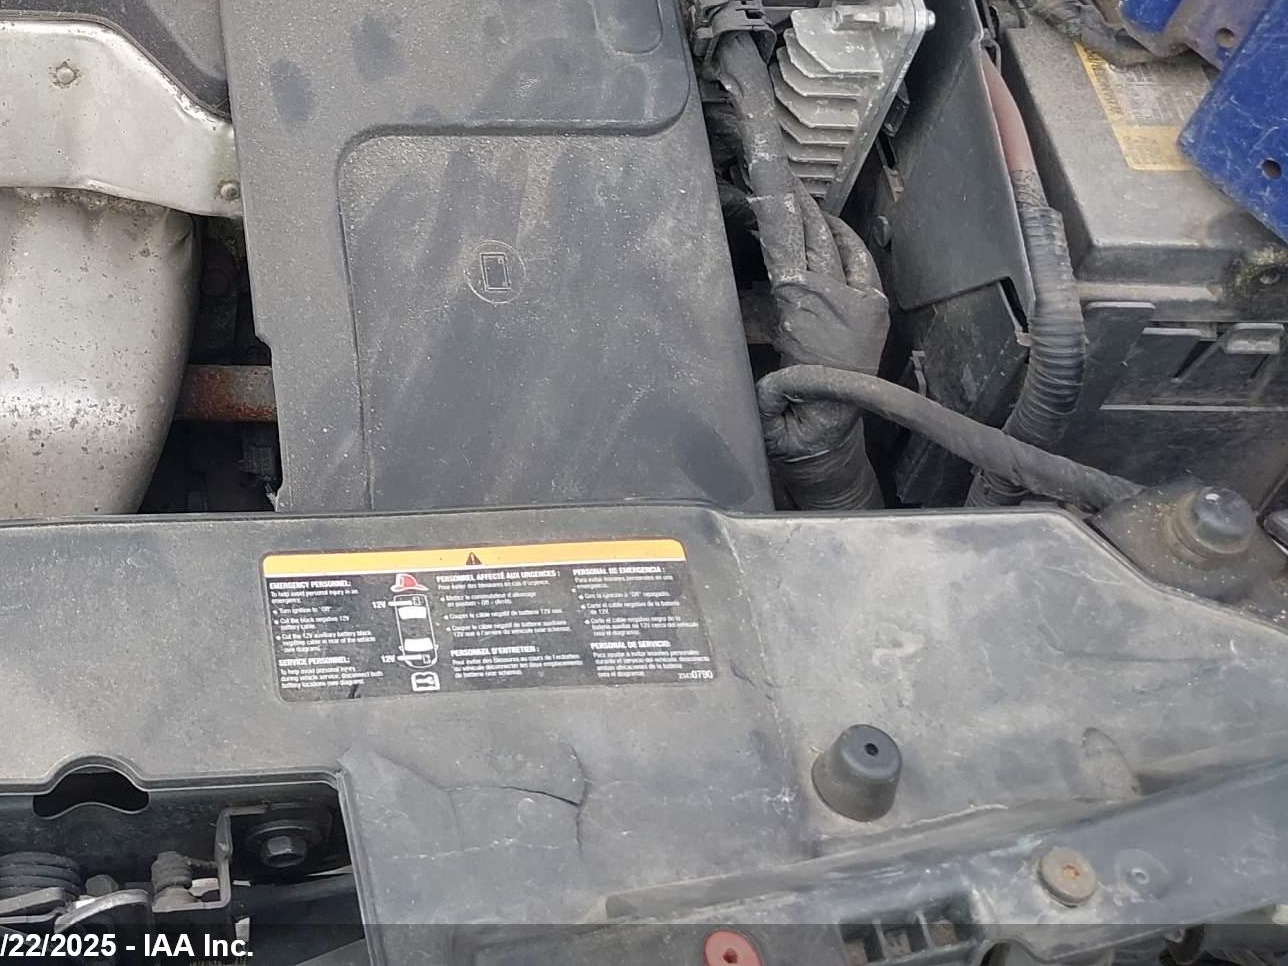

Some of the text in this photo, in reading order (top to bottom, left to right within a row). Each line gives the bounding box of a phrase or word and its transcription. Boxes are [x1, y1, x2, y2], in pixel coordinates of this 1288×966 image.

[477, 571, 505, 580] AFFECTÉ
[311, 580, 351, 588] PERSONNEL:
[372, 601, 386, 609] 12V
[308, 656, 350, 665] PERSONNEL:
[381, 655, 395, 663] 12V
